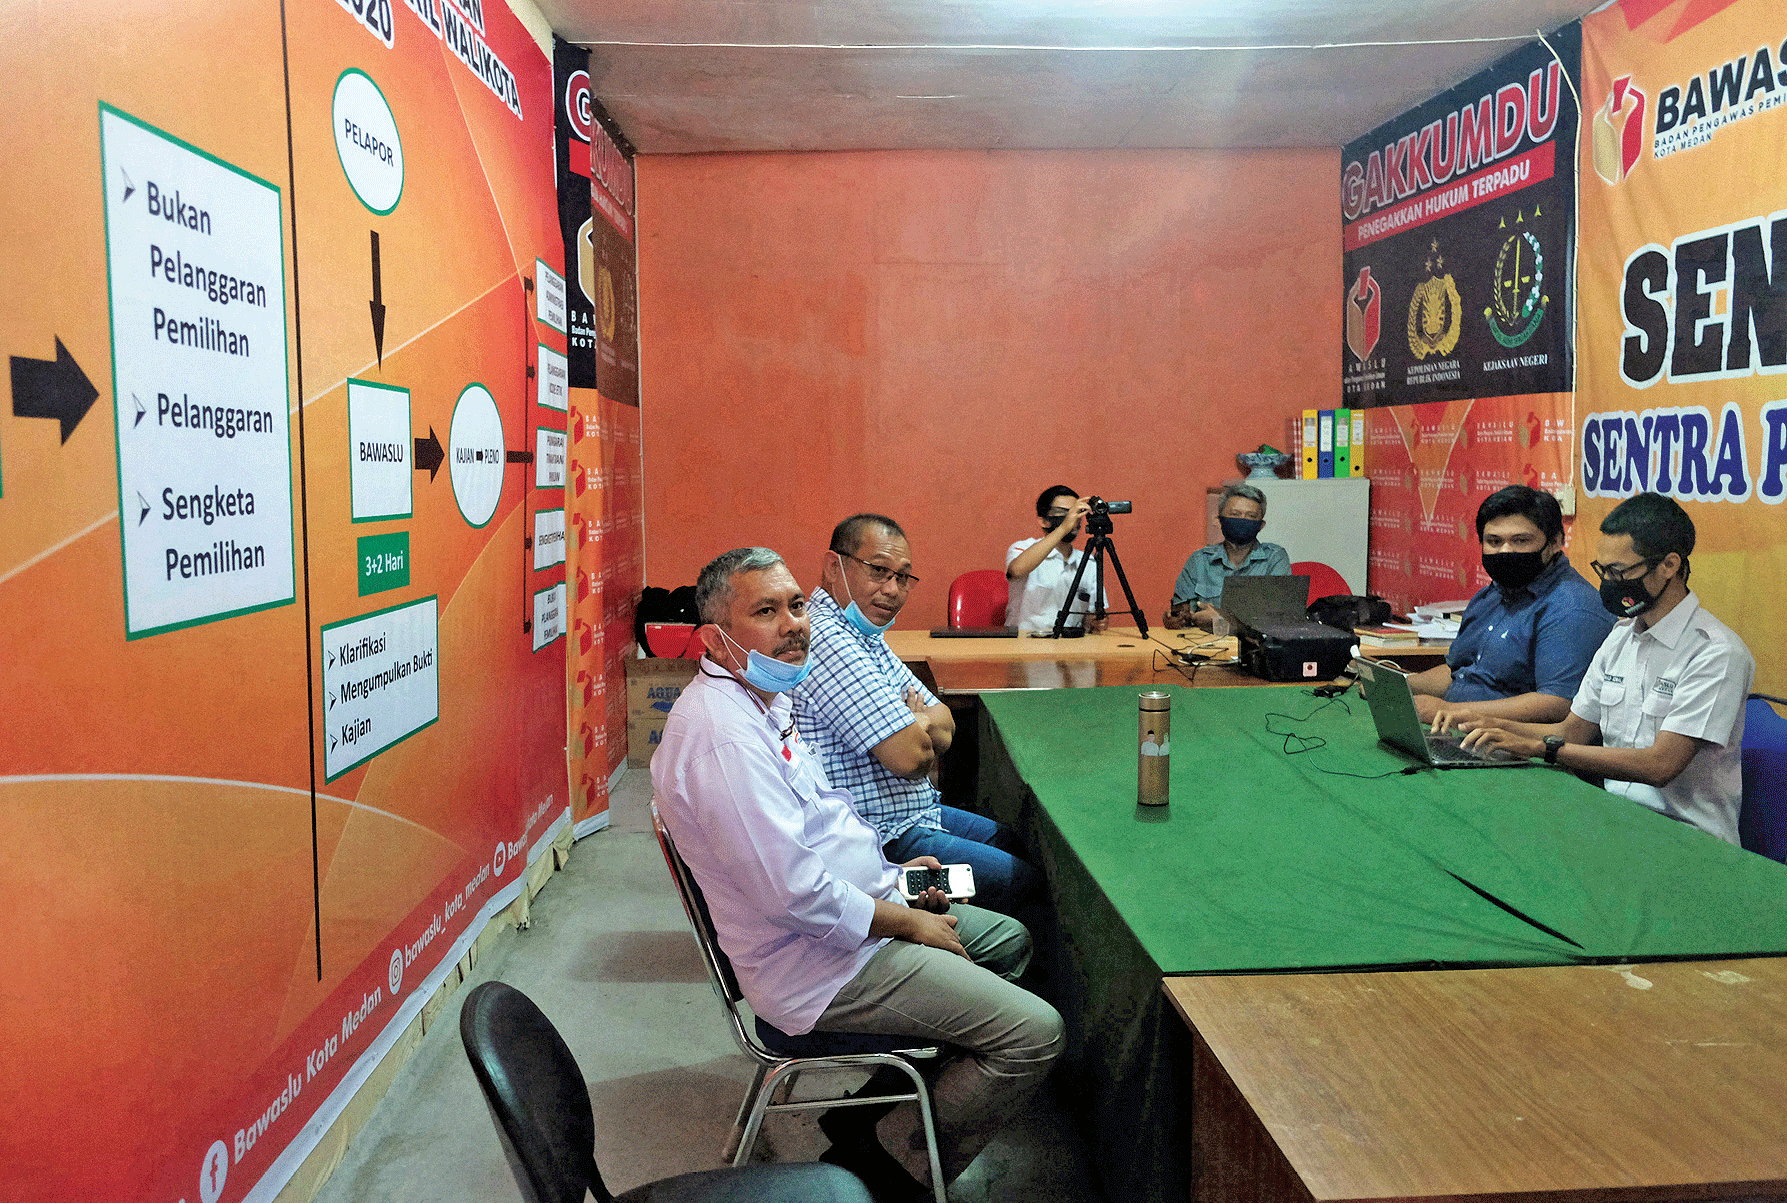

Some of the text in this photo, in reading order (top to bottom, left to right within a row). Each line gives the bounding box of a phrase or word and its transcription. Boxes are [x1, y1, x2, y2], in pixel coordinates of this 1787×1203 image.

[441, 1, 522, 117] WALIKOTA
[345, 118, 394, 167] PELAPOR
[1342, 59, 1561, 220] GAKKUMDU
[1654, 129, 1688, 148] BADAN
[1692, 105, 1754, 135] PENGAWAS
[1654, 133, 1712, 159] KOTA MEDAN
[147, 180, 211, 236] Bukan
[1358, 159, 1531, 241] PENEGAKKAN HUKUM TERPADU
[151, 244, 266, 307] Pelanggaran
[154, 307, 249, 357] Pemilihan
[1519, 354, 1548, 368] NEGERI
[157, 393, 273, 438] Pelanggaran
[359, 442, 404, 463] BAWASLU
[456, 447, 500, 464] KAJIAN PLENO
[1584, 409, 1748, 495] SENTRA
[162, 485, 255, 525] Sengketa
[166, 540, 265, 581] Pemilihan
[365, 551, 404, 576] 3+2 Hari
[339, 632, 386, 667] Klarifikasi
[341, 648, 433, 704] Mengumpulkan Bukti
[342, 716, 372, 746] Kajian
[404, 863, 490, 968] bawaslu_kota_medan
[234, 1073, 302, 1165] Bawaslu
[307, 1034, 338, 1083] Kota
[341, 986, 382, 1044] Medan
